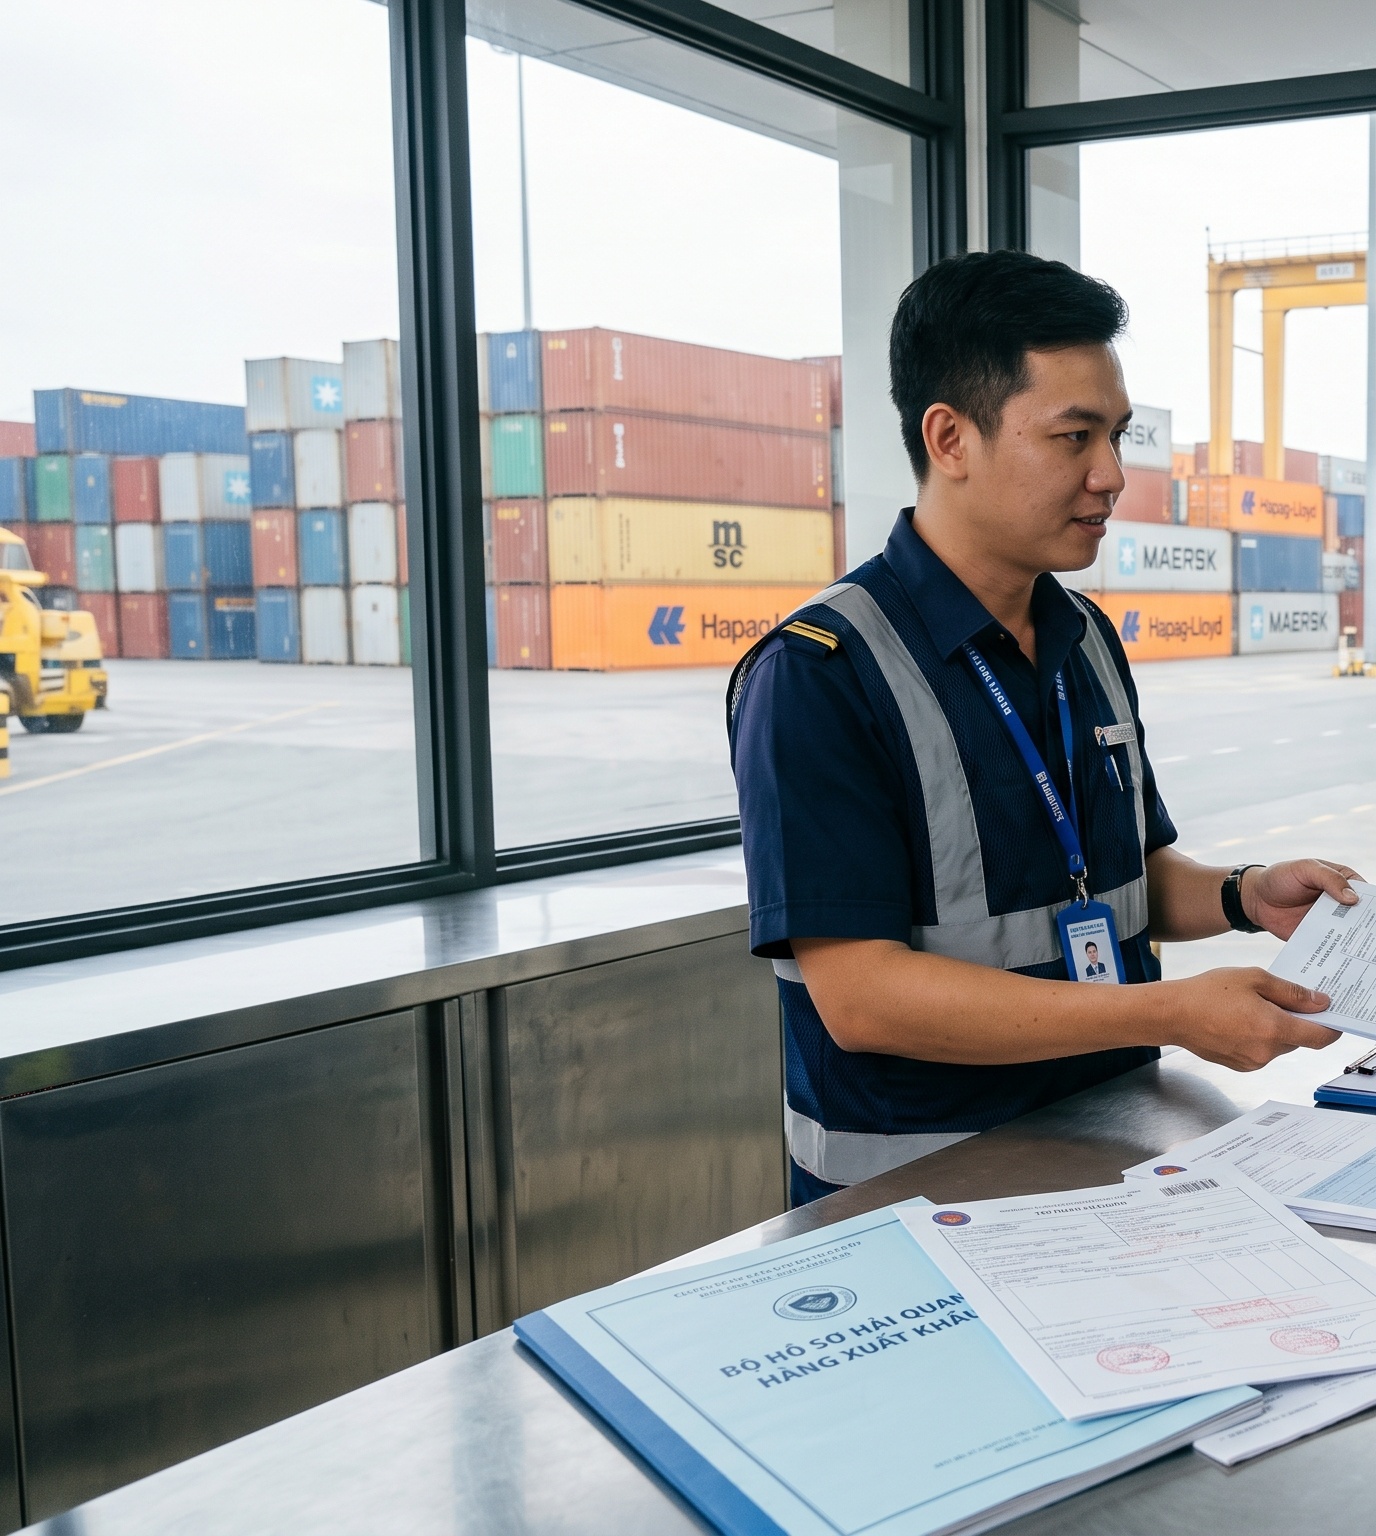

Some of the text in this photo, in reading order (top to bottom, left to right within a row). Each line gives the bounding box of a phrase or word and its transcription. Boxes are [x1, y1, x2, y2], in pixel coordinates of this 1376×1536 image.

[1259, 498, 1317, 522] Hapag-Lloyd
[1143, 545, 1217, 572] MAERSK
[1148, 615, 1224, 643] Hapag-Lloyd
[1268, 610, 1328, 634] MAERSK
[719, 1357, 762, 1379] BỘ
[809, 1331, 847, 1350] SƠ
[848, 1316, 899, 1337] HẢI
[756, 1355, 841, 1389] HÀNG
[839, 1332, 910, 1362] XUẤT
